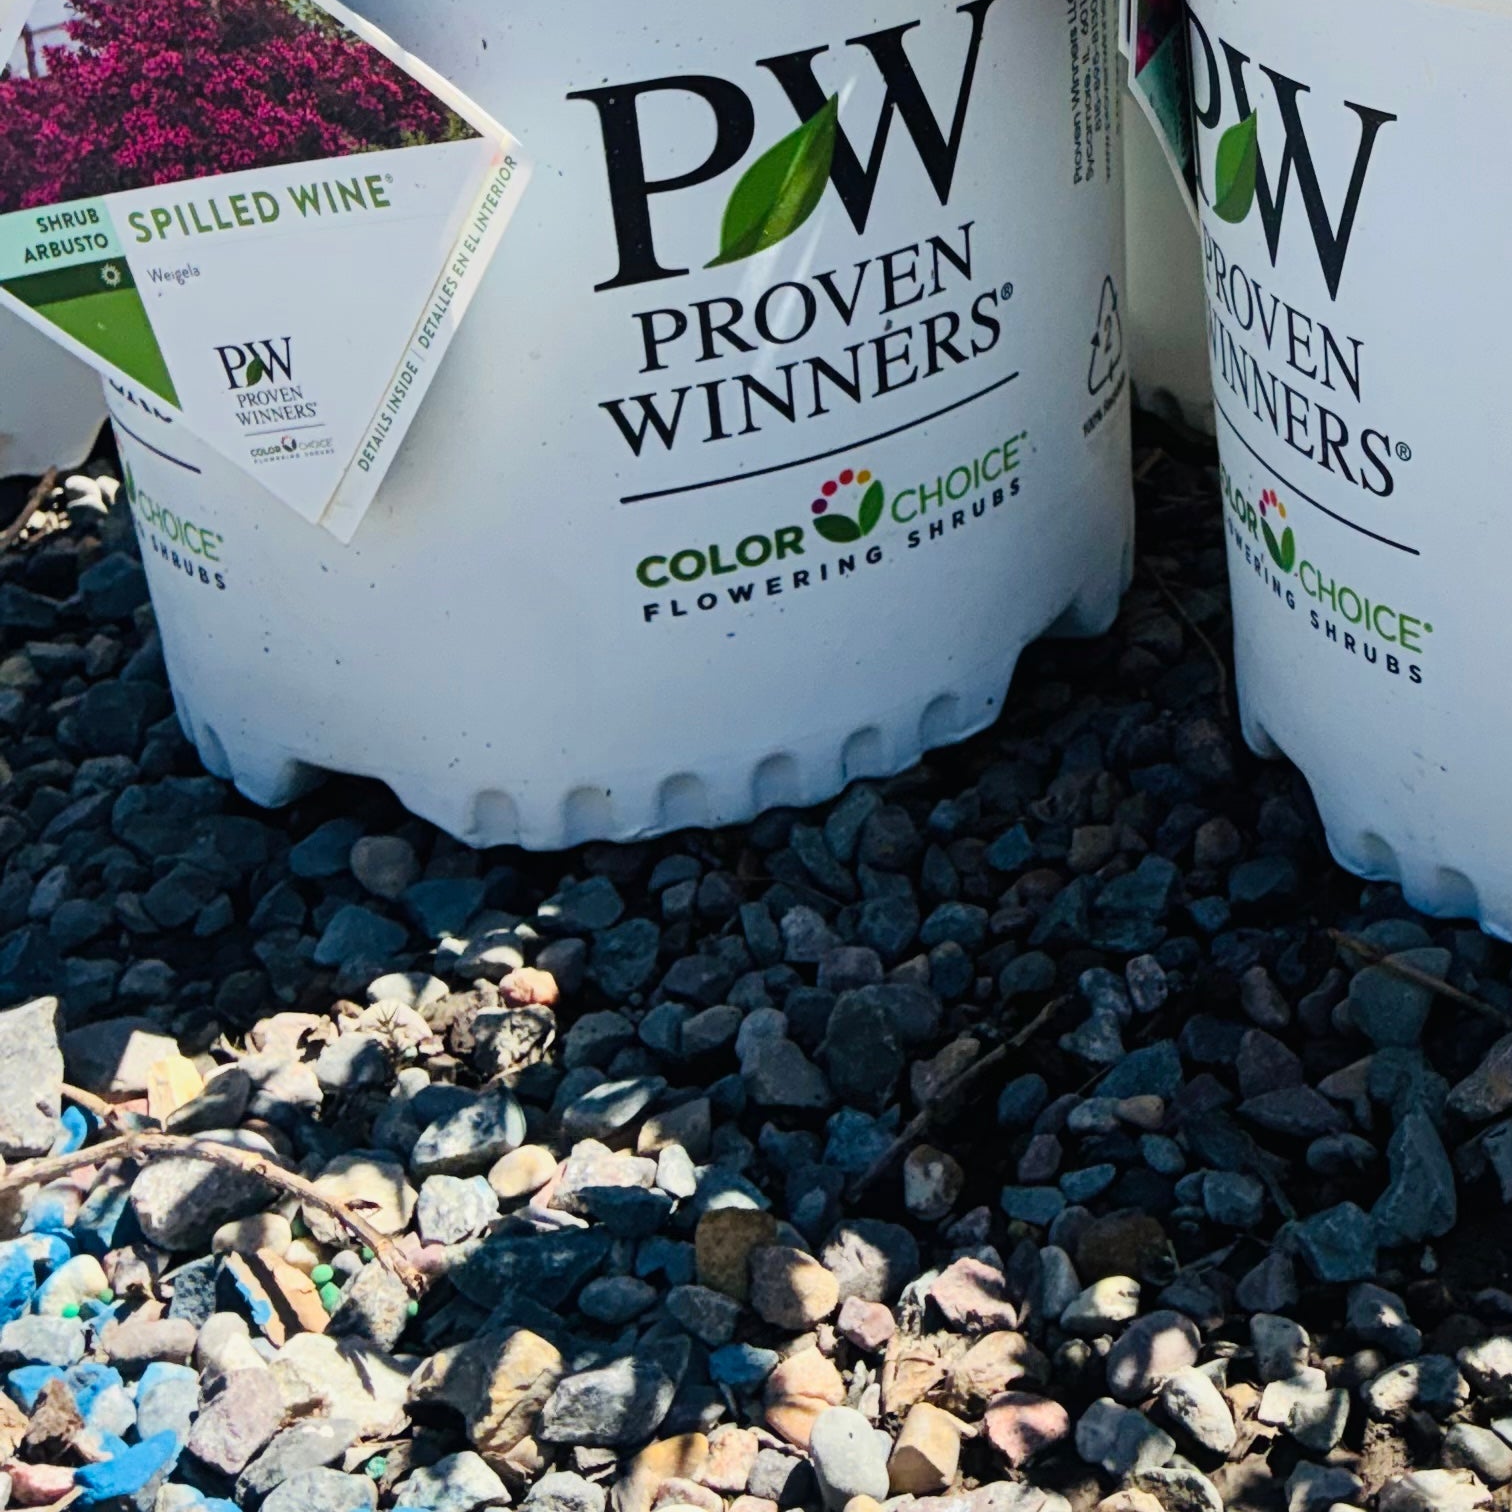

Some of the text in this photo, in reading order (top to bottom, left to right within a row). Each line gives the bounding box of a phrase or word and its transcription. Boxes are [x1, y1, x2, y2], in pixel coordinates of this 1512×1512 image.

[1069, 27, 1080, 111] Winners
[1073, 112, 1083, 185] Proven
[24, 233, 109, 264] ARBUSTO
[36, 208, 100, 233] SHRUB
[127, 191, 280, 243] SPILLED
[147, 263, 201, 286] Weigela
[632, 221, 975, 373] PROVEN
[357, 155, 518, 472] DETAILS INSIDE DETALLES EN EL INTERIOR
[213, 337, 291, 390] PW
[237, 386, 304, 408] PROVEN
[635, 525, 804, 588] COLOR
[644, 477, 1020, 622] FLOWERING SHRUBS
[1311, 609, 1423, 685] SHRUBS
